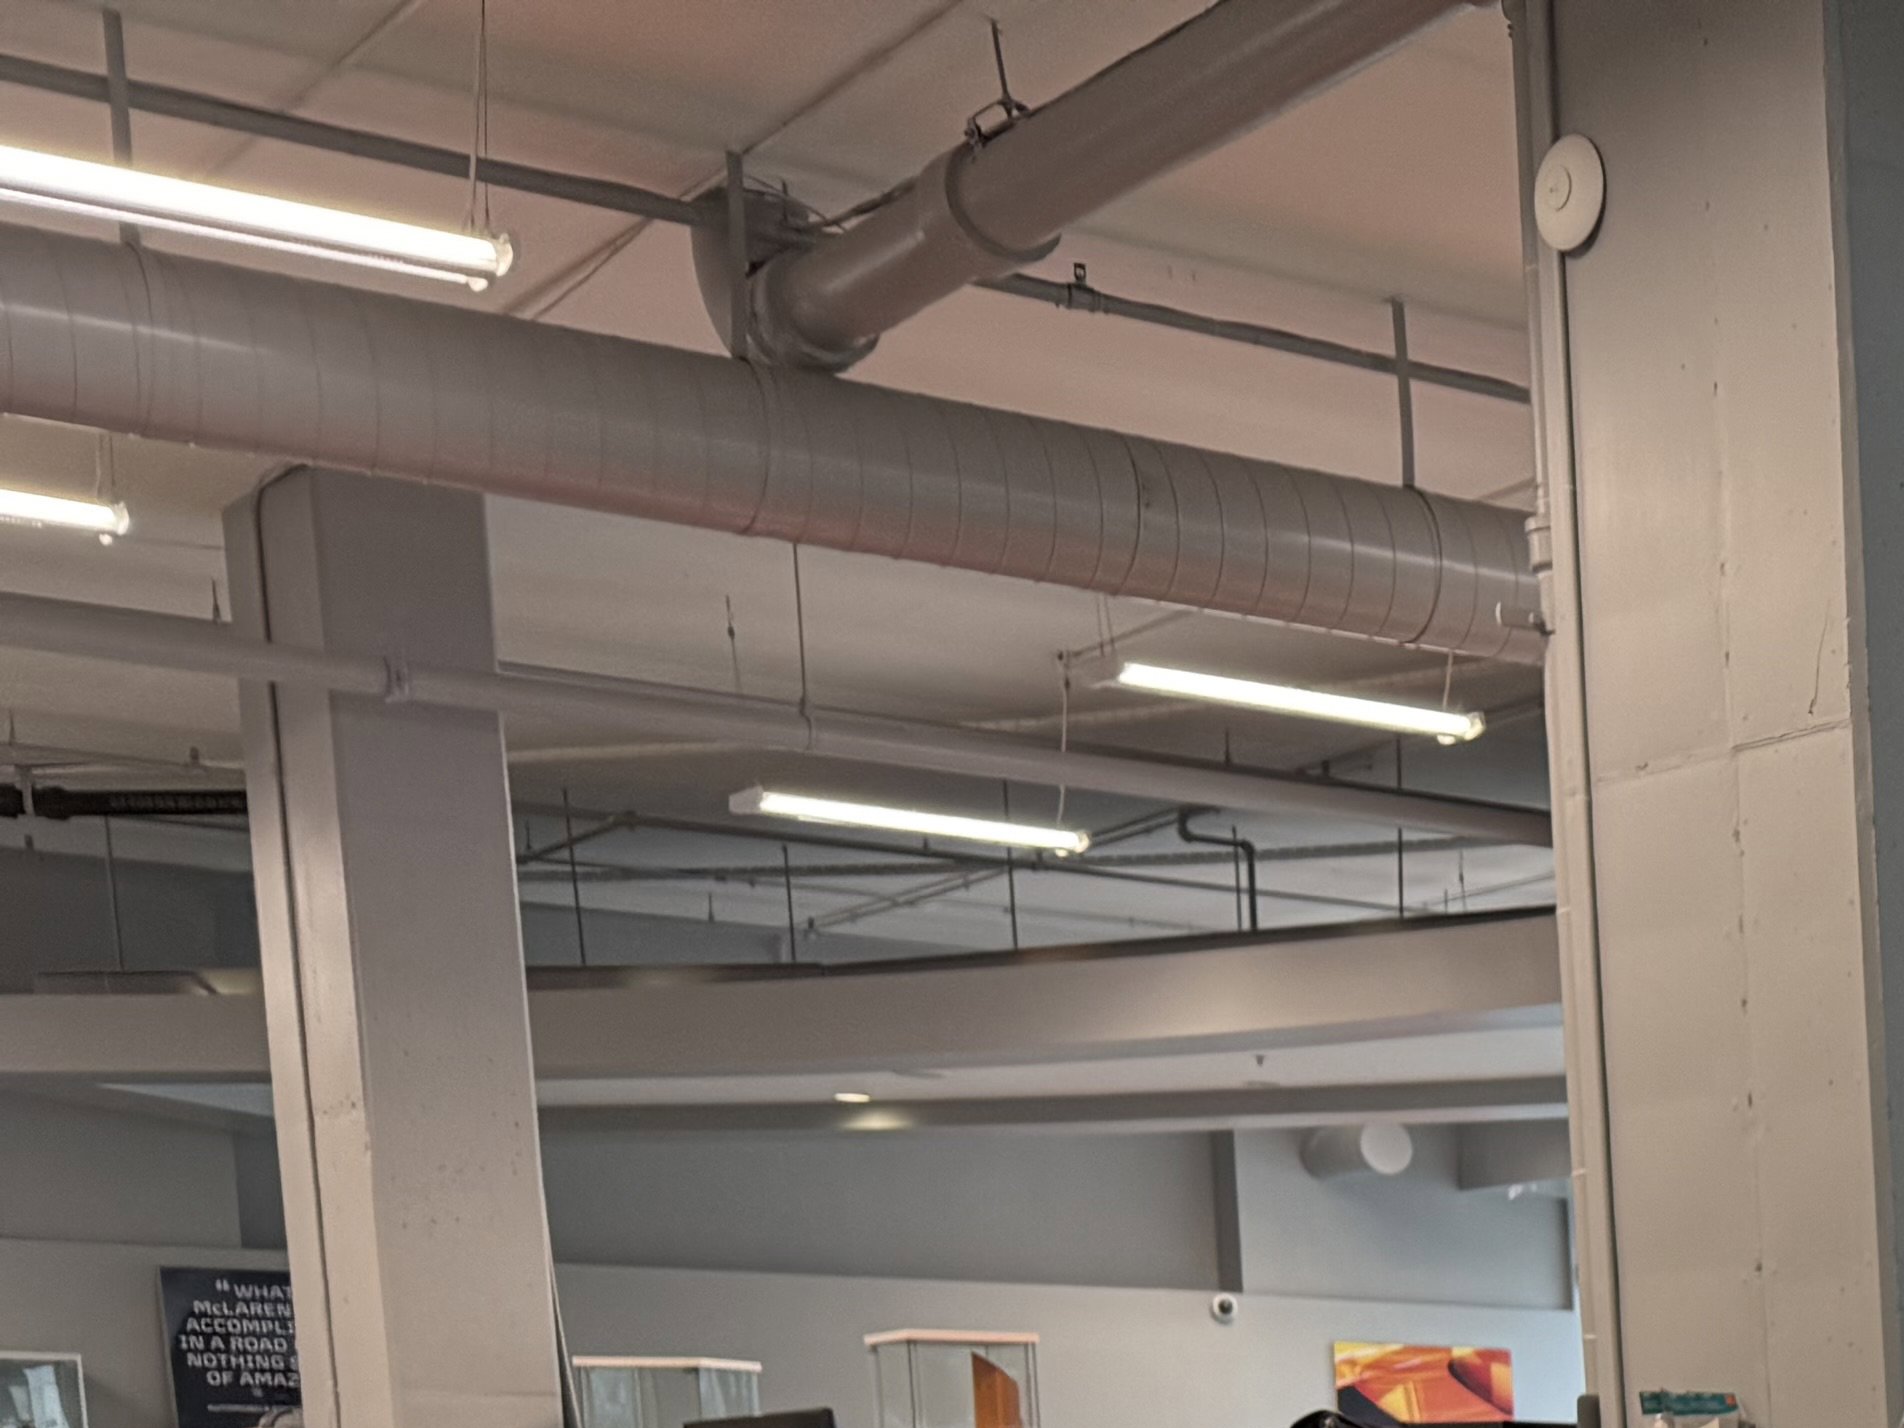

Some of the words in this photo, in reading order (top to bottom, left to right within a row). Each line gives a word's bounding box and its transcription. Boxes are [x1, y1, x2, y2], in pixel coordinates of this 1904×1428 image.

[180, 1334, 204, 1350] IN
[210, 1336, 225, 1351] A
[230, 1337, 288, 1353] ROAD
[187, 1353, 285, 1370] NOTHING
[206, 1371, 233, 1386] OF
